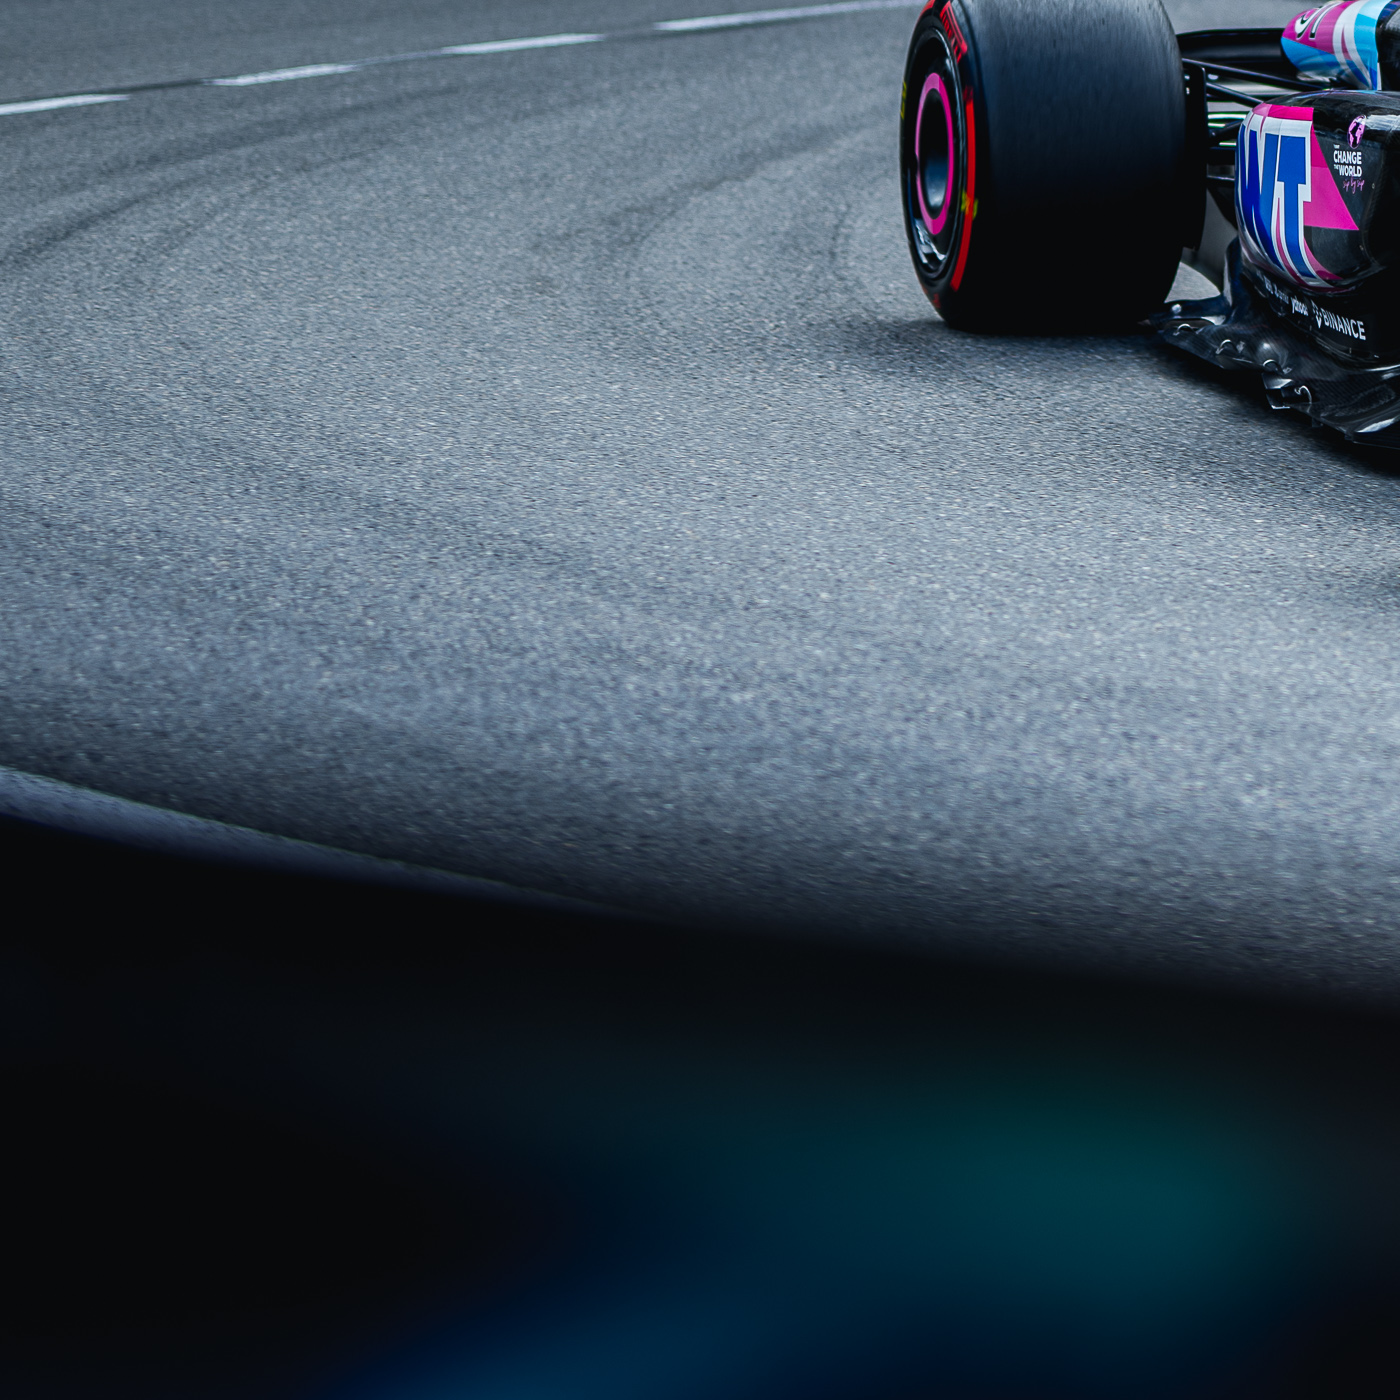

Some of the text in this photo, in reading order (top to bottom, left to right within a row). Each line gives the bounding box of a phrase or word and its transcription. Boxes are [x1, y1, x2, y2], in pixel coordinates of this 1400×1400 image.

[1333, 150, 1362, 165] CHANGE
[1339, 165, 1363, 178] WORLD
[1320, 307, 1366, 341] BINANCE
